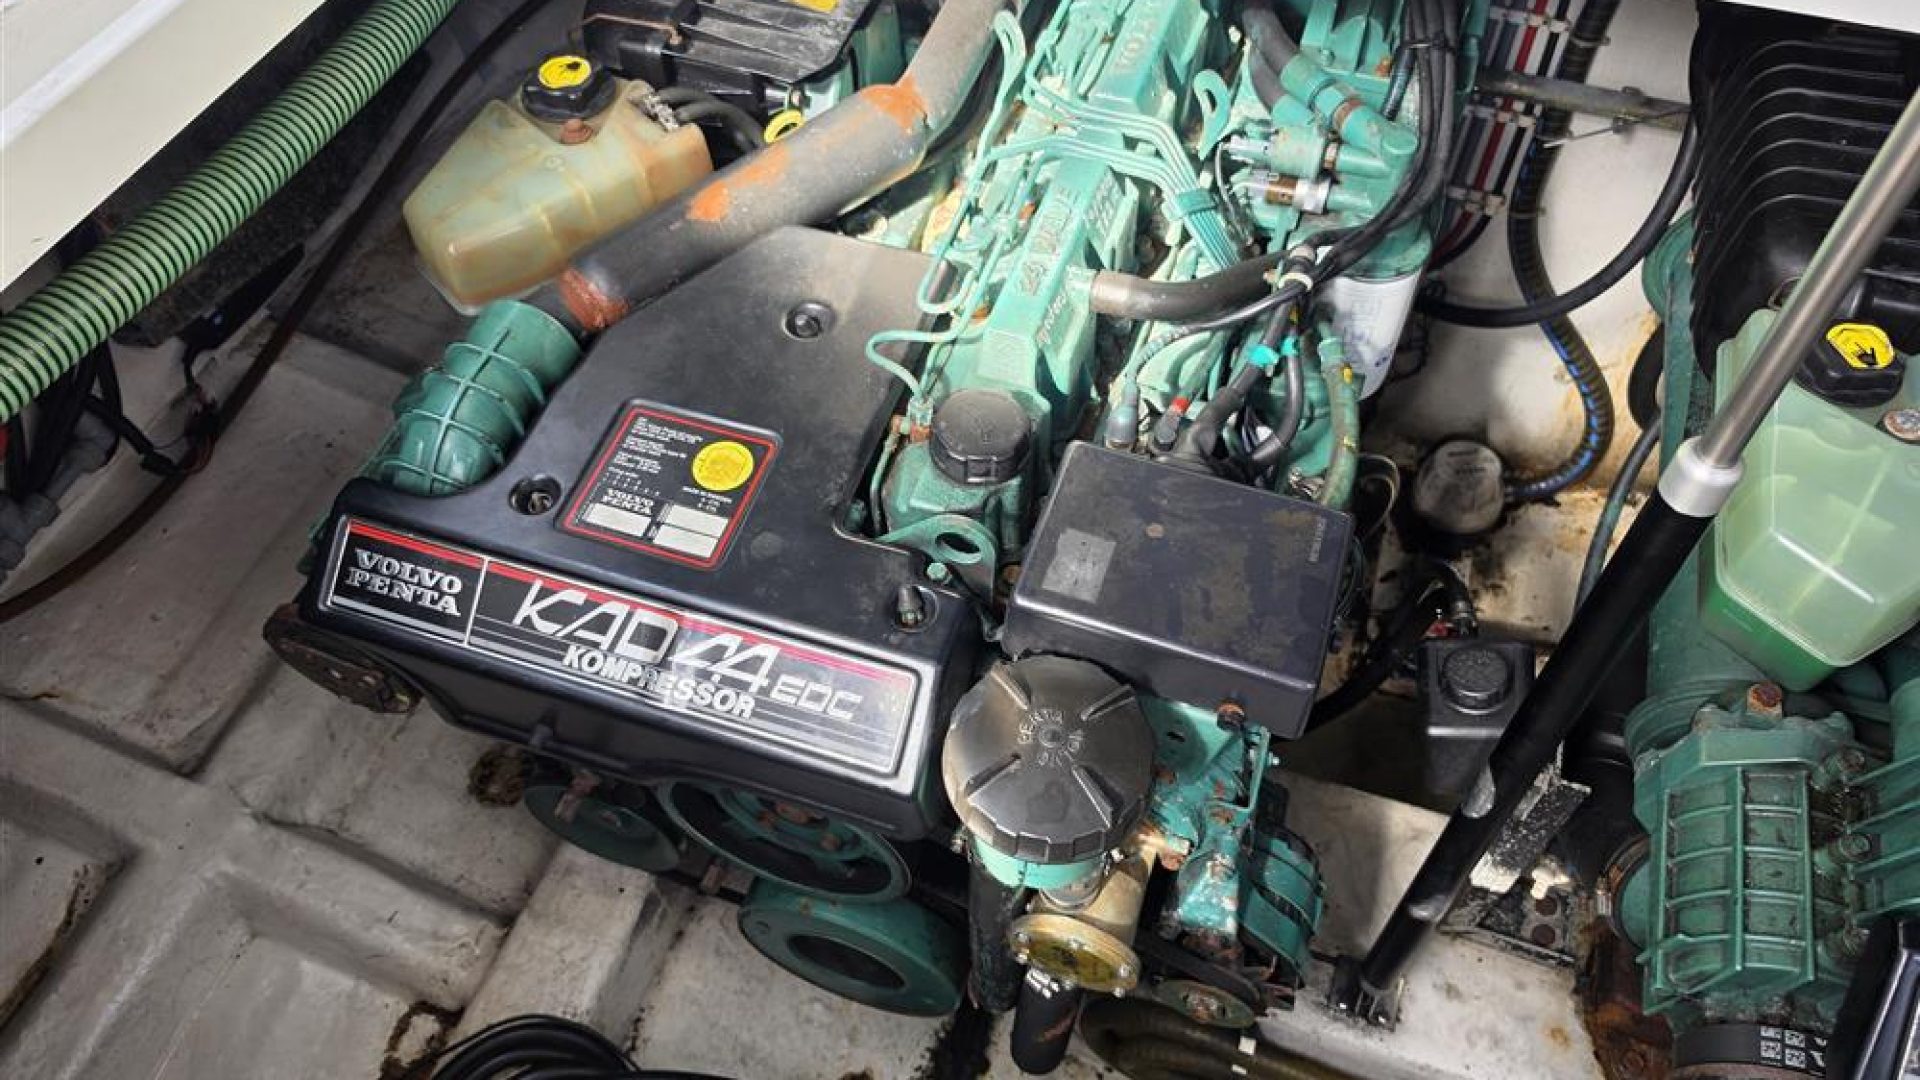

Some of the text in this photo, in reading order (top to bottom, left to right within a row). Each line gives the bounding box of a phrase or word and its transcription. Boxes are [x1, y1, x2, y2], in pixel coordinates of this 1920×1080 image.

[346, 567, 462, 617] PENTA
[355, 548, 462, 595] VOLVO
[562, 644, 755, 719] KOMPRESSOR
[771, 675, 863, 718] EDC
